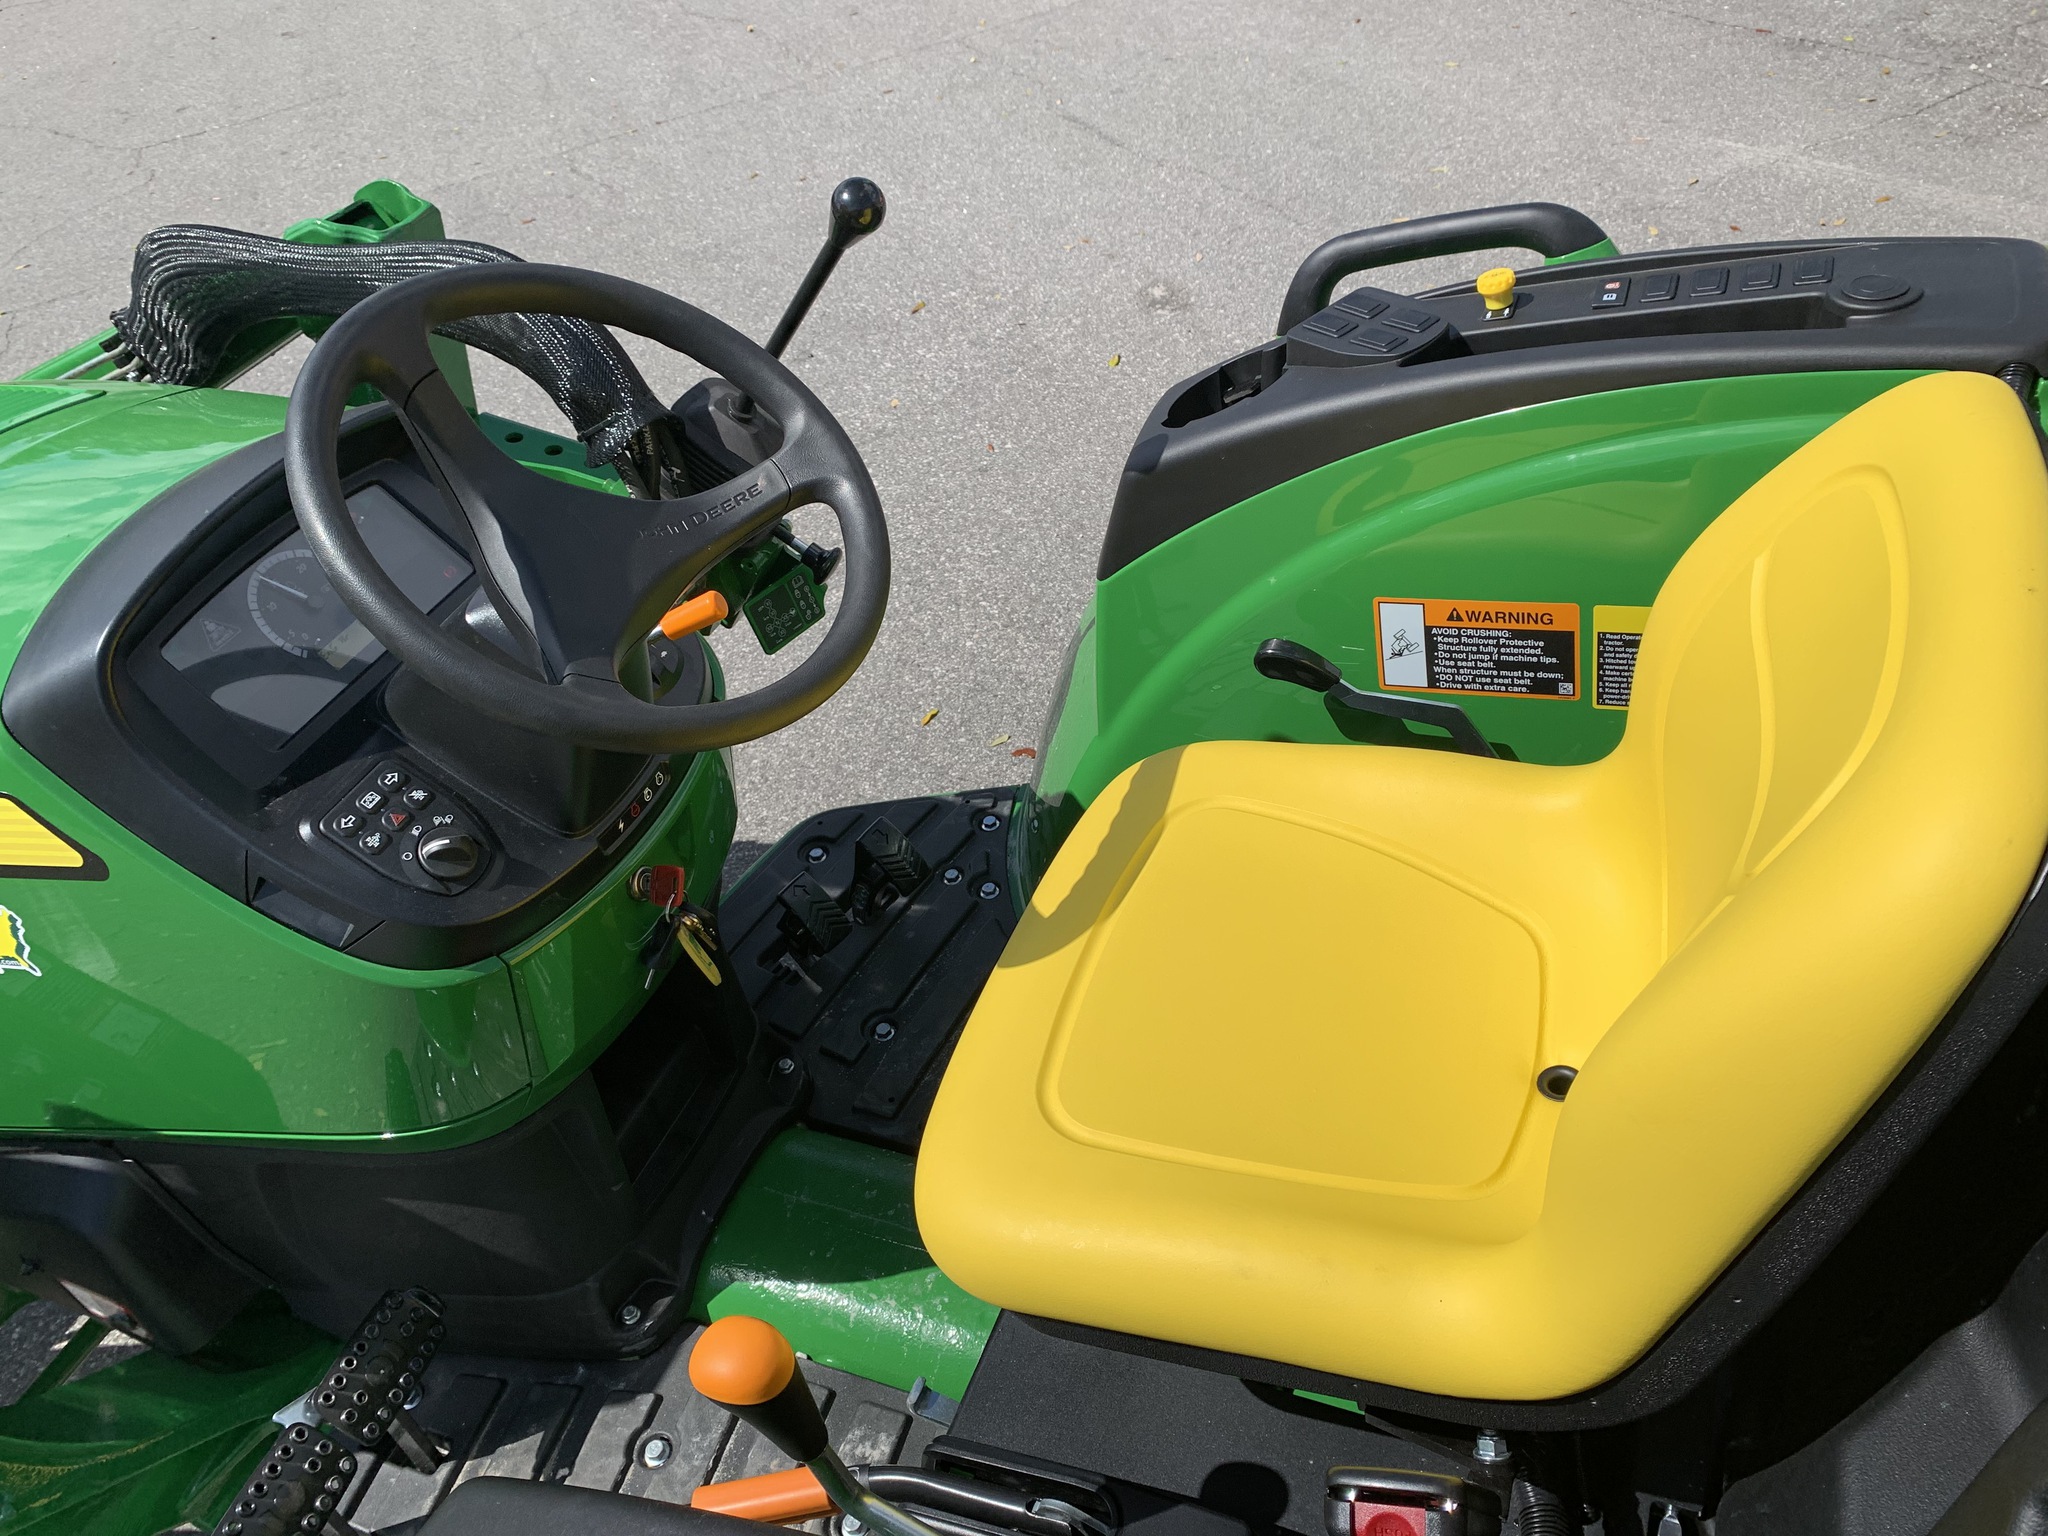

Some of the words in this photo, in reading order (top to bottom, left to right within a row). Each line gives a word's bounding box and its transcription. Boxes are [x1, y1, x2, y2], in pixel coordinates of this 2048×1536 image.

[688, 482, 764, 526] DEERE
[1465, 610, 1554, 626] WARNING
[1432, 628, 1458, 636] AVOID
[1461, 629, 1512, 637] CRUSHING:
[1438, 636, 1459, 644] Keep
[1462, 637, 1497, 645] Rollover
[1500, 639, 1544, 647] Protective
[1479, 646, 1498, 654] fully
[1501, 647, 1543, 655] extended.
[1540, 656, 1559, 664] tips.
[1433, 666, 1457, 674] When
[1460, 668, 1498, 676] structure
[1524, 670, 1535, 678] be
